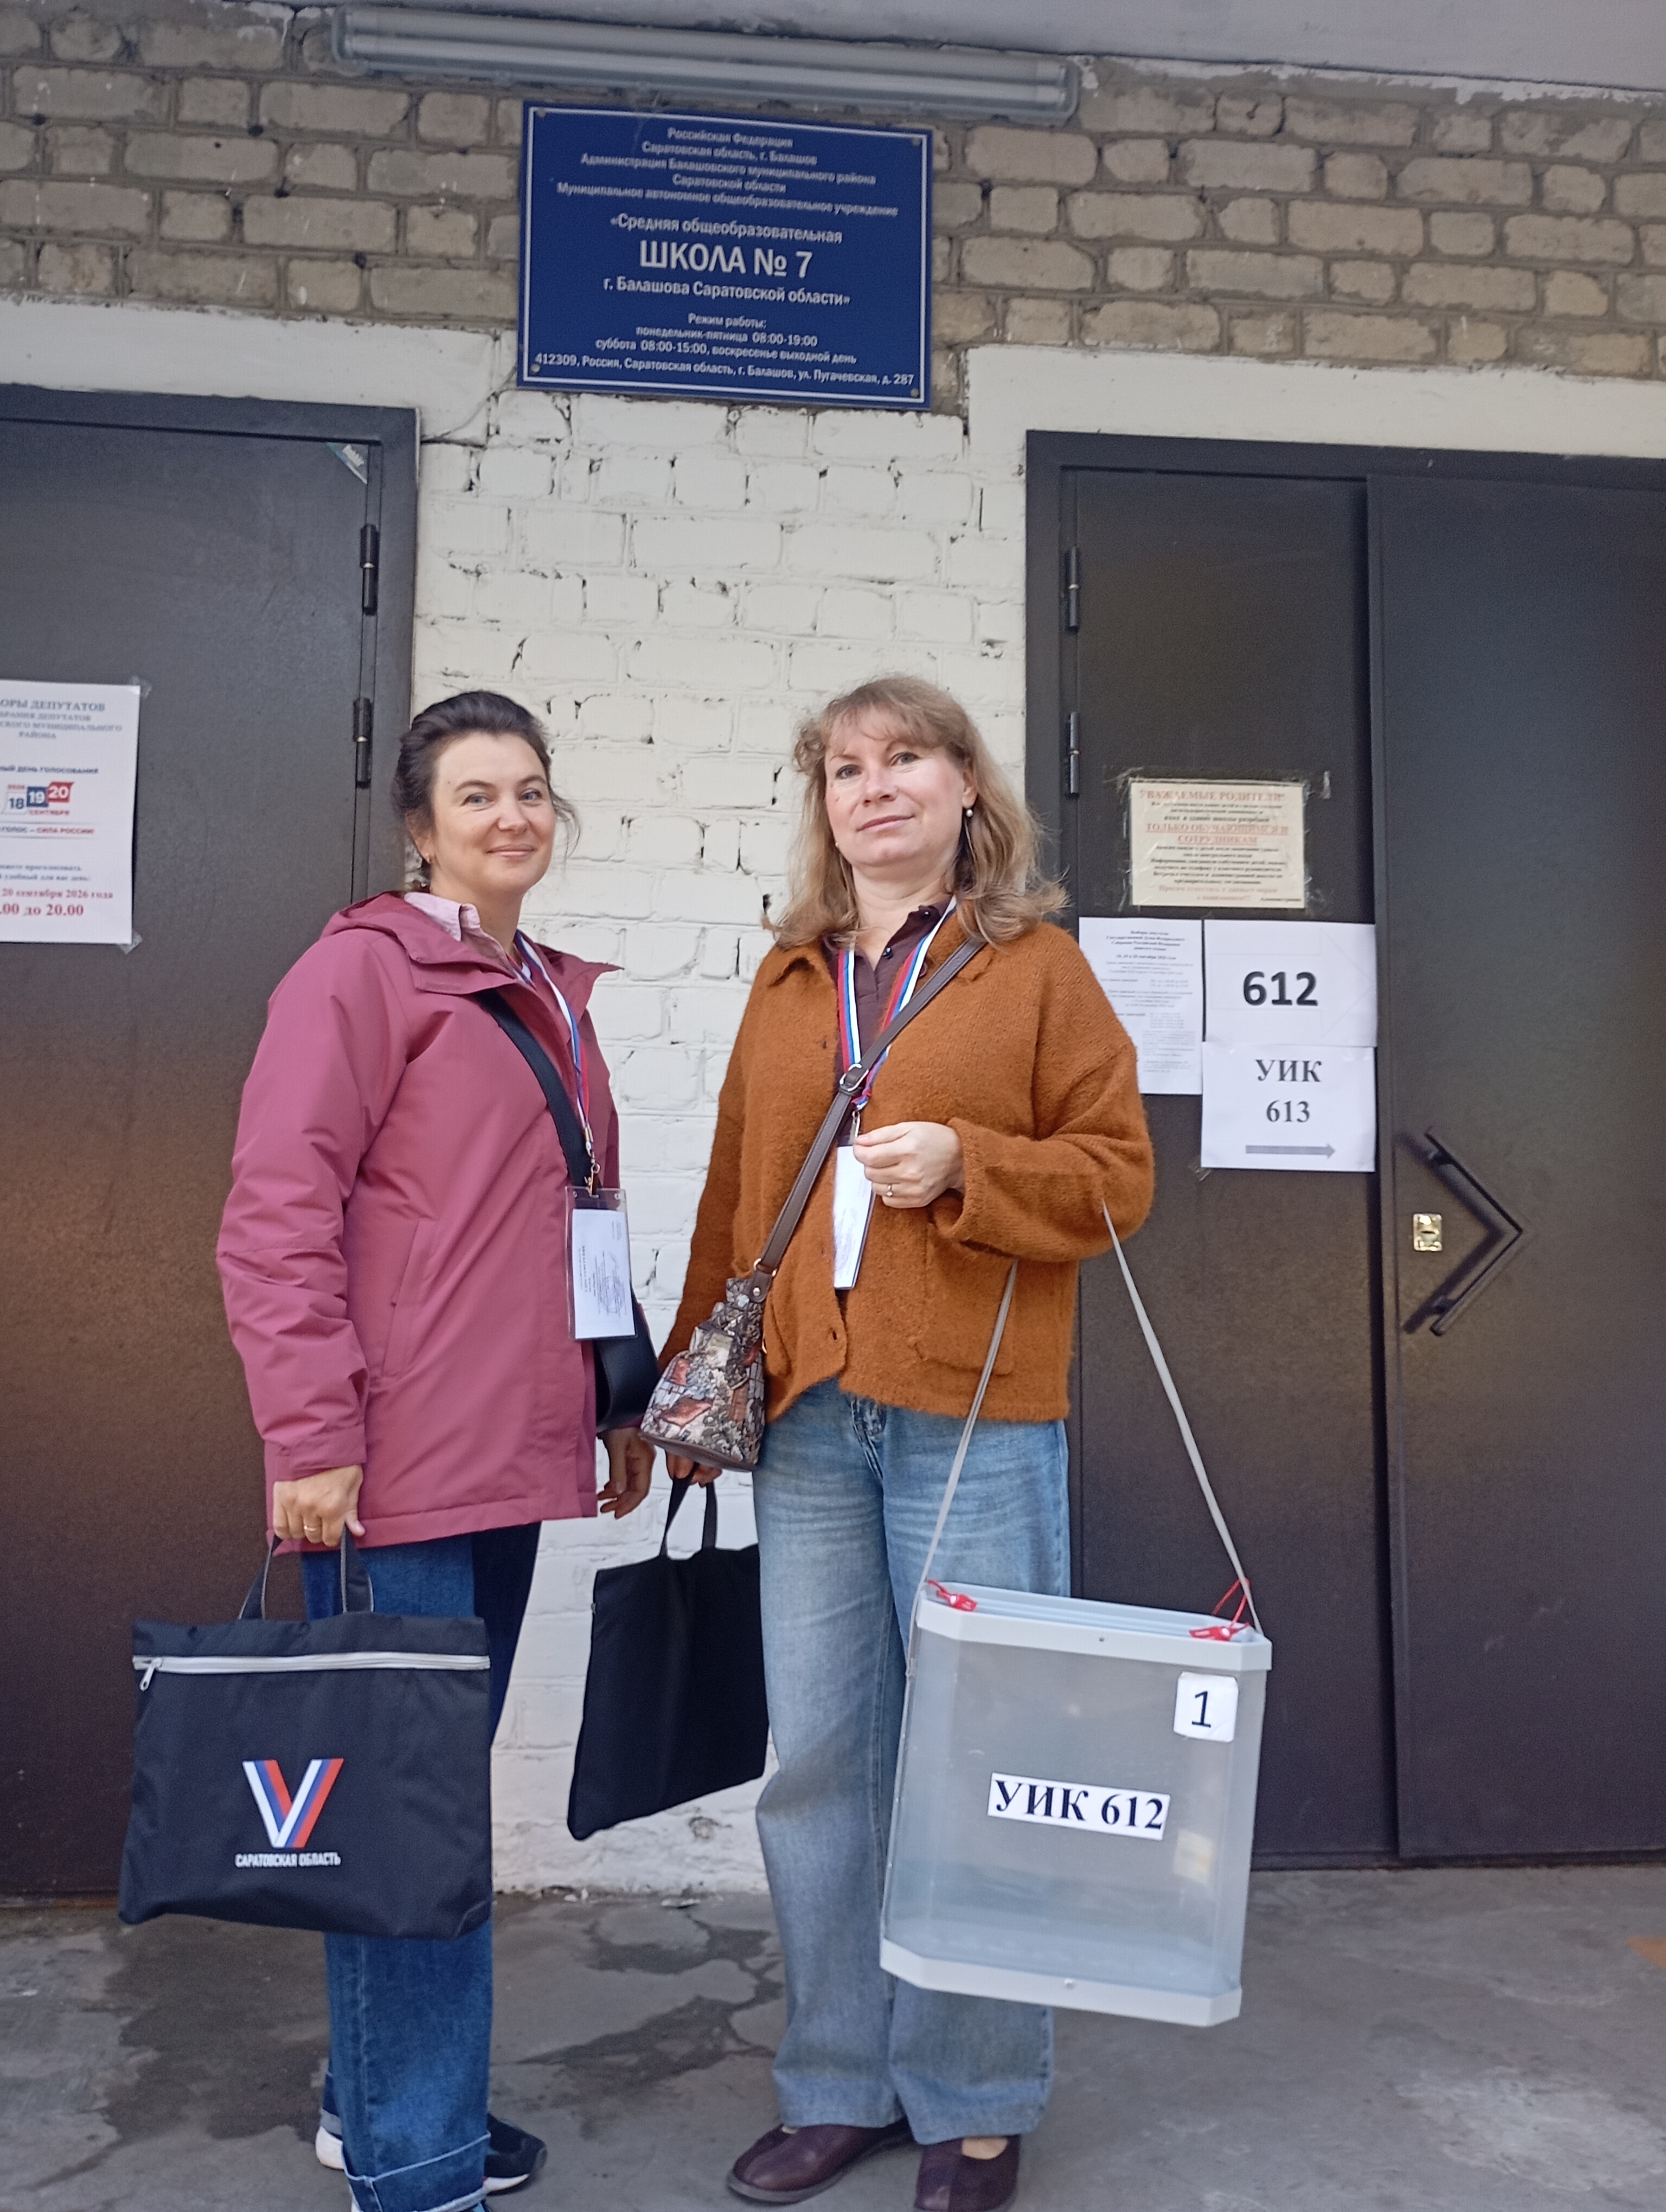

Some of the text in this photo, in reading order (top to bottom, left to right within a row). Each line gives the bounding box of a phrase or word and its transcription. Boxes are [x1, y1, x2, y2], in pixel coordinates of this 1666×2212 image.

[668, 127, 793, 147] Российская Федерация
[642, 141, 712, 156] Саратовская
[769, 150, 817, 165] Балашов
[580, 153, 876, 185] Администрация Балашовского муниципального района
[672, 173, 786, 193] Саратовской области
[557, 182, 898, 216] Муниципальное автономное общеобразовательное учреждение
[610, 213, 842, 243] «Средняя общеобразовательная
[639, 240, 813, 278] ШКОЛА № 7
[603, 275, 850, 305] г. Балашова Саратовской области»
[688, 312, 723, 326] Режим
[636, 326, 818, 347] понедельник-пятница 08:00-19:00
[595, 337, 636, 352] суббота
[712, 346, 777, 359] воскресенье
[779, 350, 830, 363] выходной
[832, 354, 857, 364] день
[535, 352, 914, 385] 412309, Россия, Саратовская область, г. Балашов, ул. Пугачевская, д. 287
[30, 699, 106, 712] ДЕПУТАТОВ
[19, 730, 56, 739] РАЙОНА
[9, 786, 69, 809] 18 19 20
[66, 889, 89, 898] 2026
[23, 906, 41, 916] до
[46, 904, 84, 917] 20.00
[1243, 971, 1318, 1006] 612
[1255, 1059, 1323, 1083] УИК
[1266, 1099, 1311, 1123] 613
[1191, 1689, 1213, 1729] 1
[995, 1779, 1163, 1831] УИК 612
[235, 1851, 341, 1868] САРАТОВСКАЯ ОБЛАСТЬ
